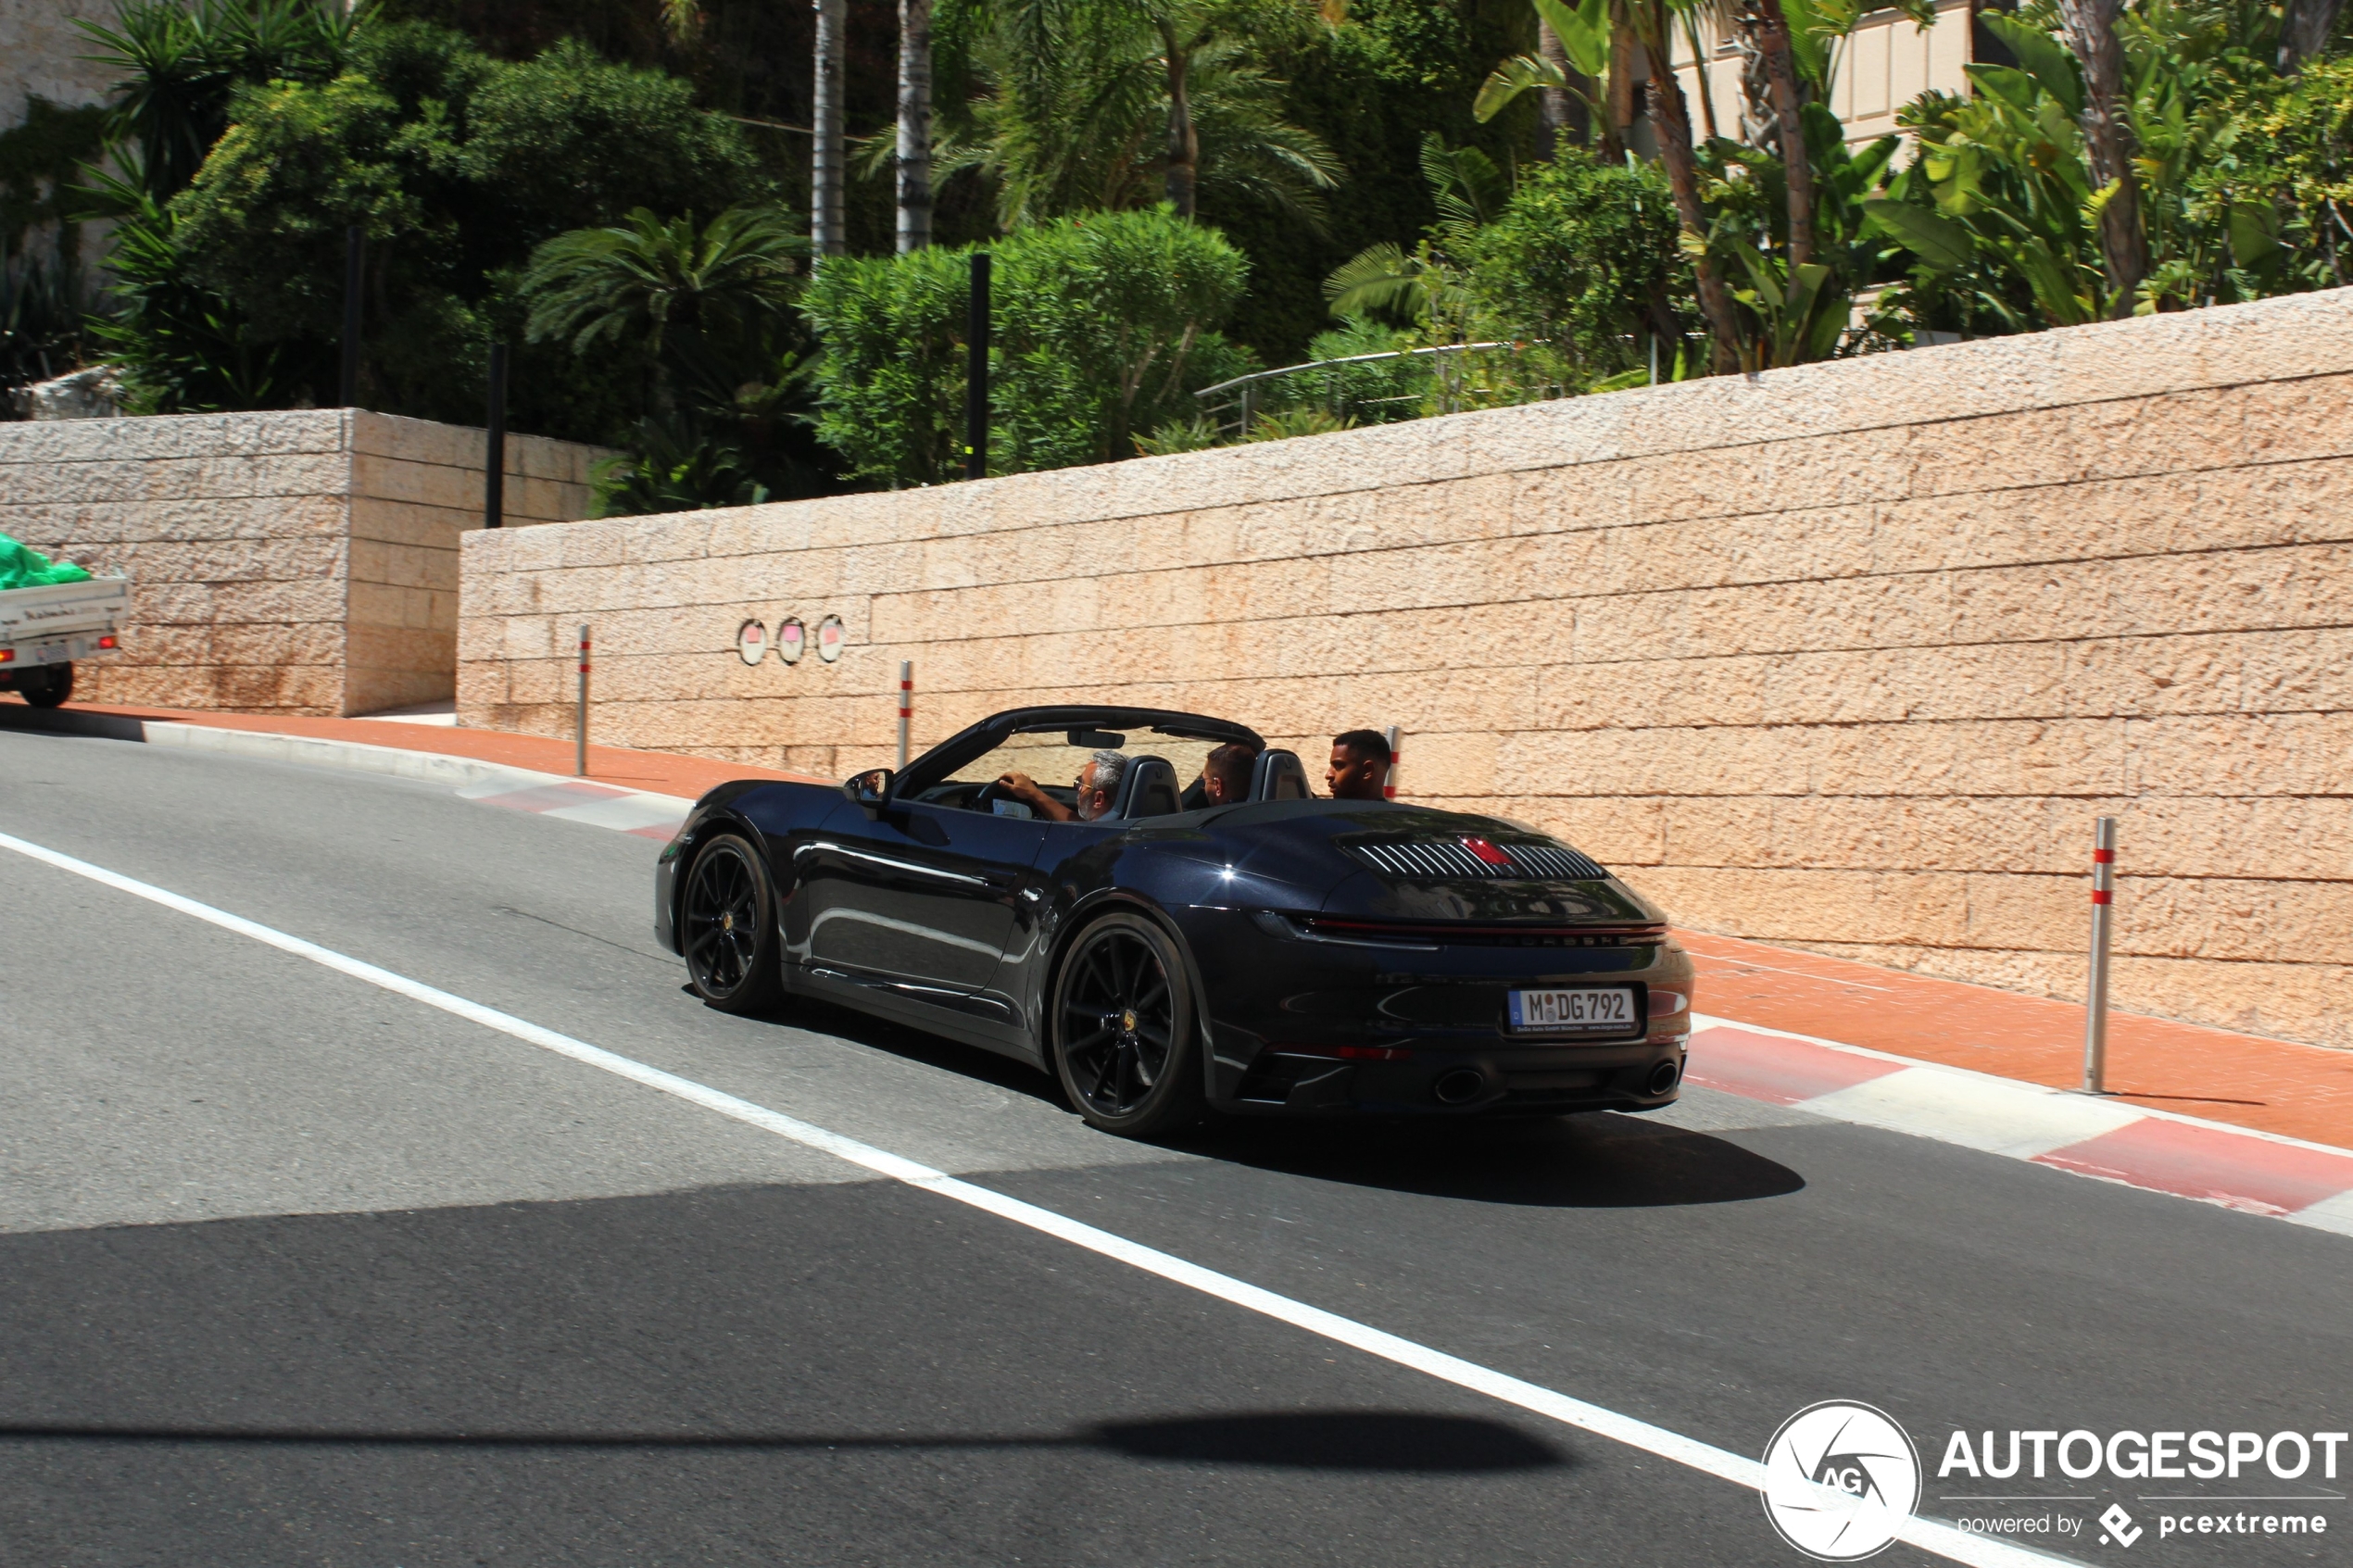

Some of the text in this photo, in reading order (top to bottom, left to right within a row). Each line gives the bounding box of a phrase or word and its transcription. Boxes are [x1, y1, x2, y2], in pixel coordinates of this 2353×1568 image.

[1529, 993, 1626, 1021] M DG 792
